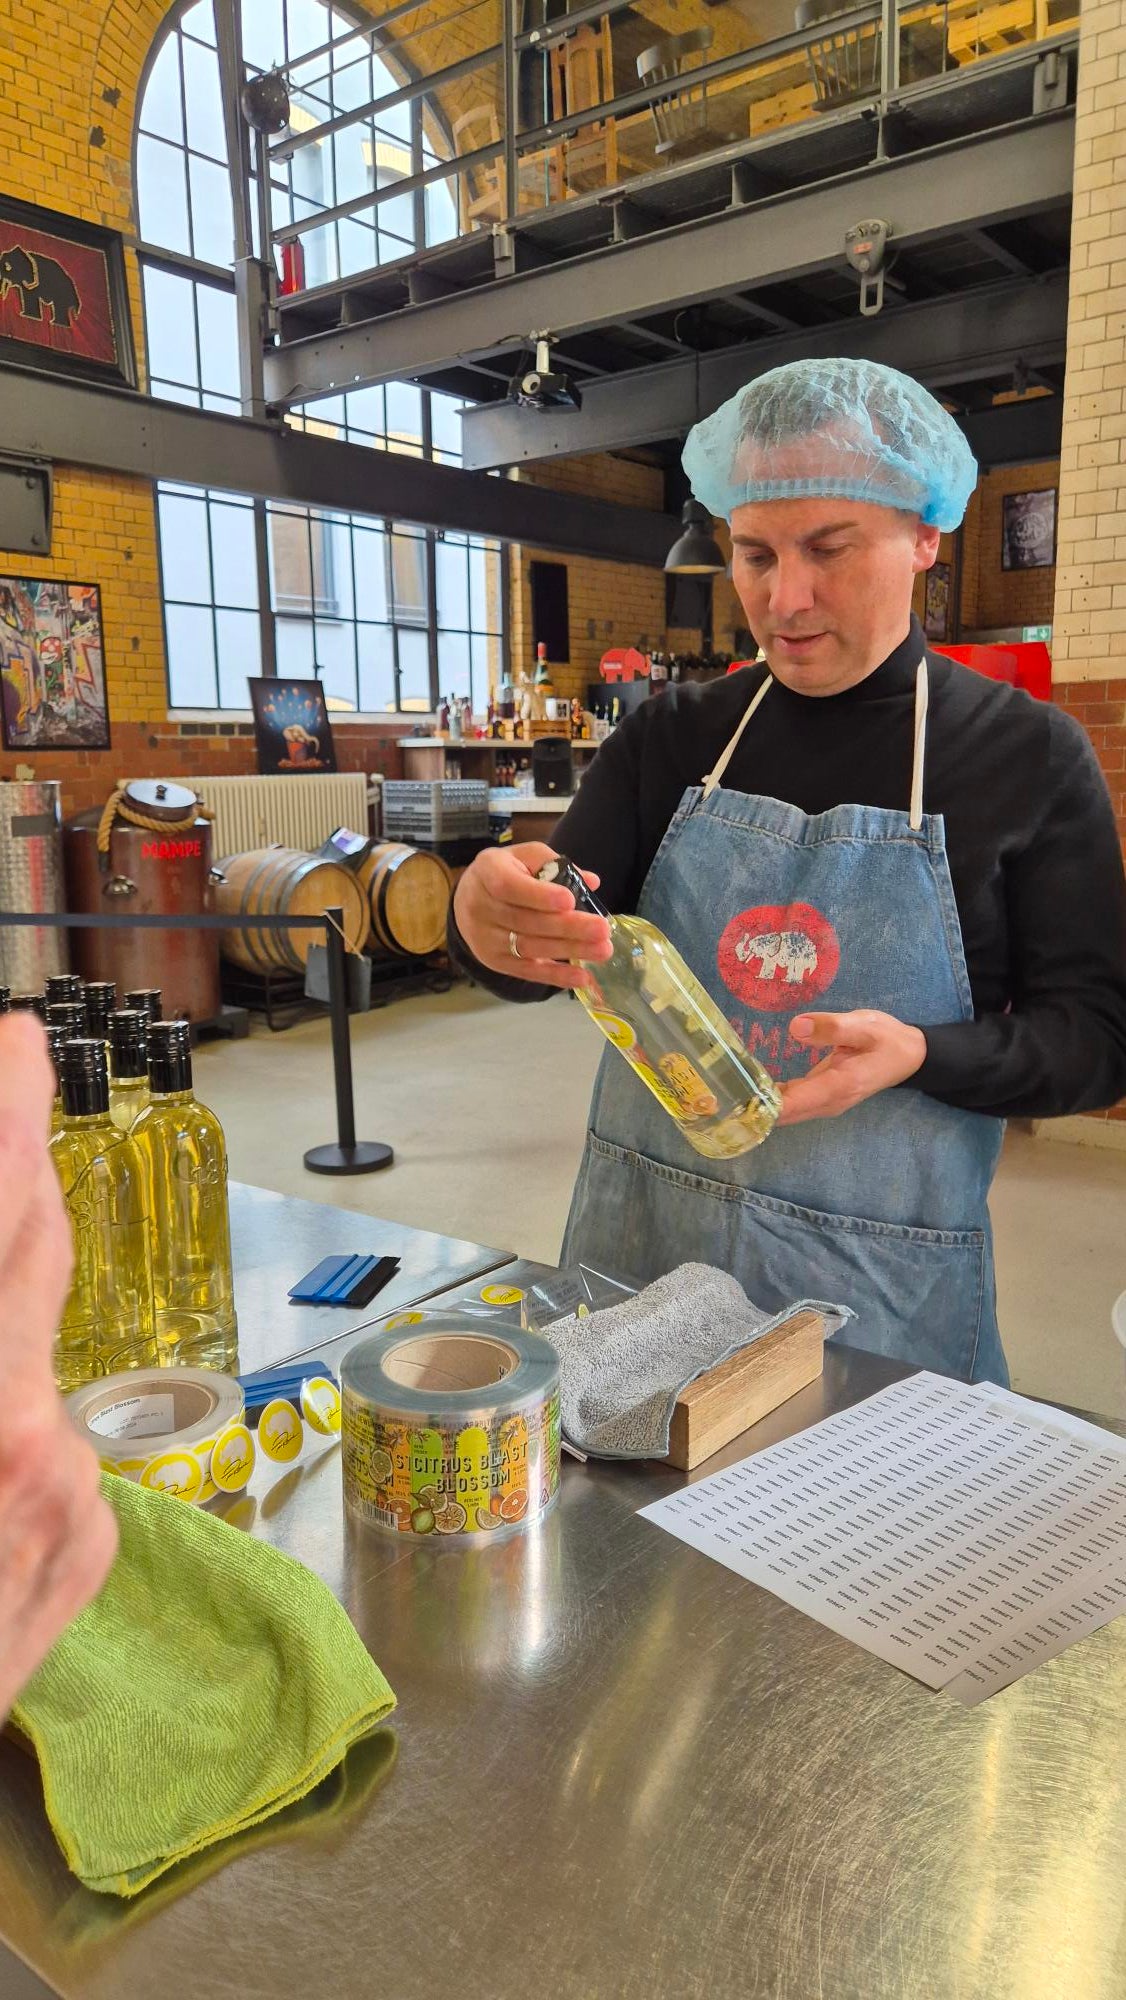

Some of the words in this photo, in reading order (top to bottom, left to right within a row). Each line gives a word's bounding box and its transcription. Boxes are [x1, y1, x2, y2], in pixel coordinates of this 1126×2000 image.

[141, 839, 201, 859] MAMPE
[414, 1455, 473, 1474] CITRUS
[480, 1441, 527, 1470] BLAST
[436, 1468, 510, 1494] BLOSSOM
